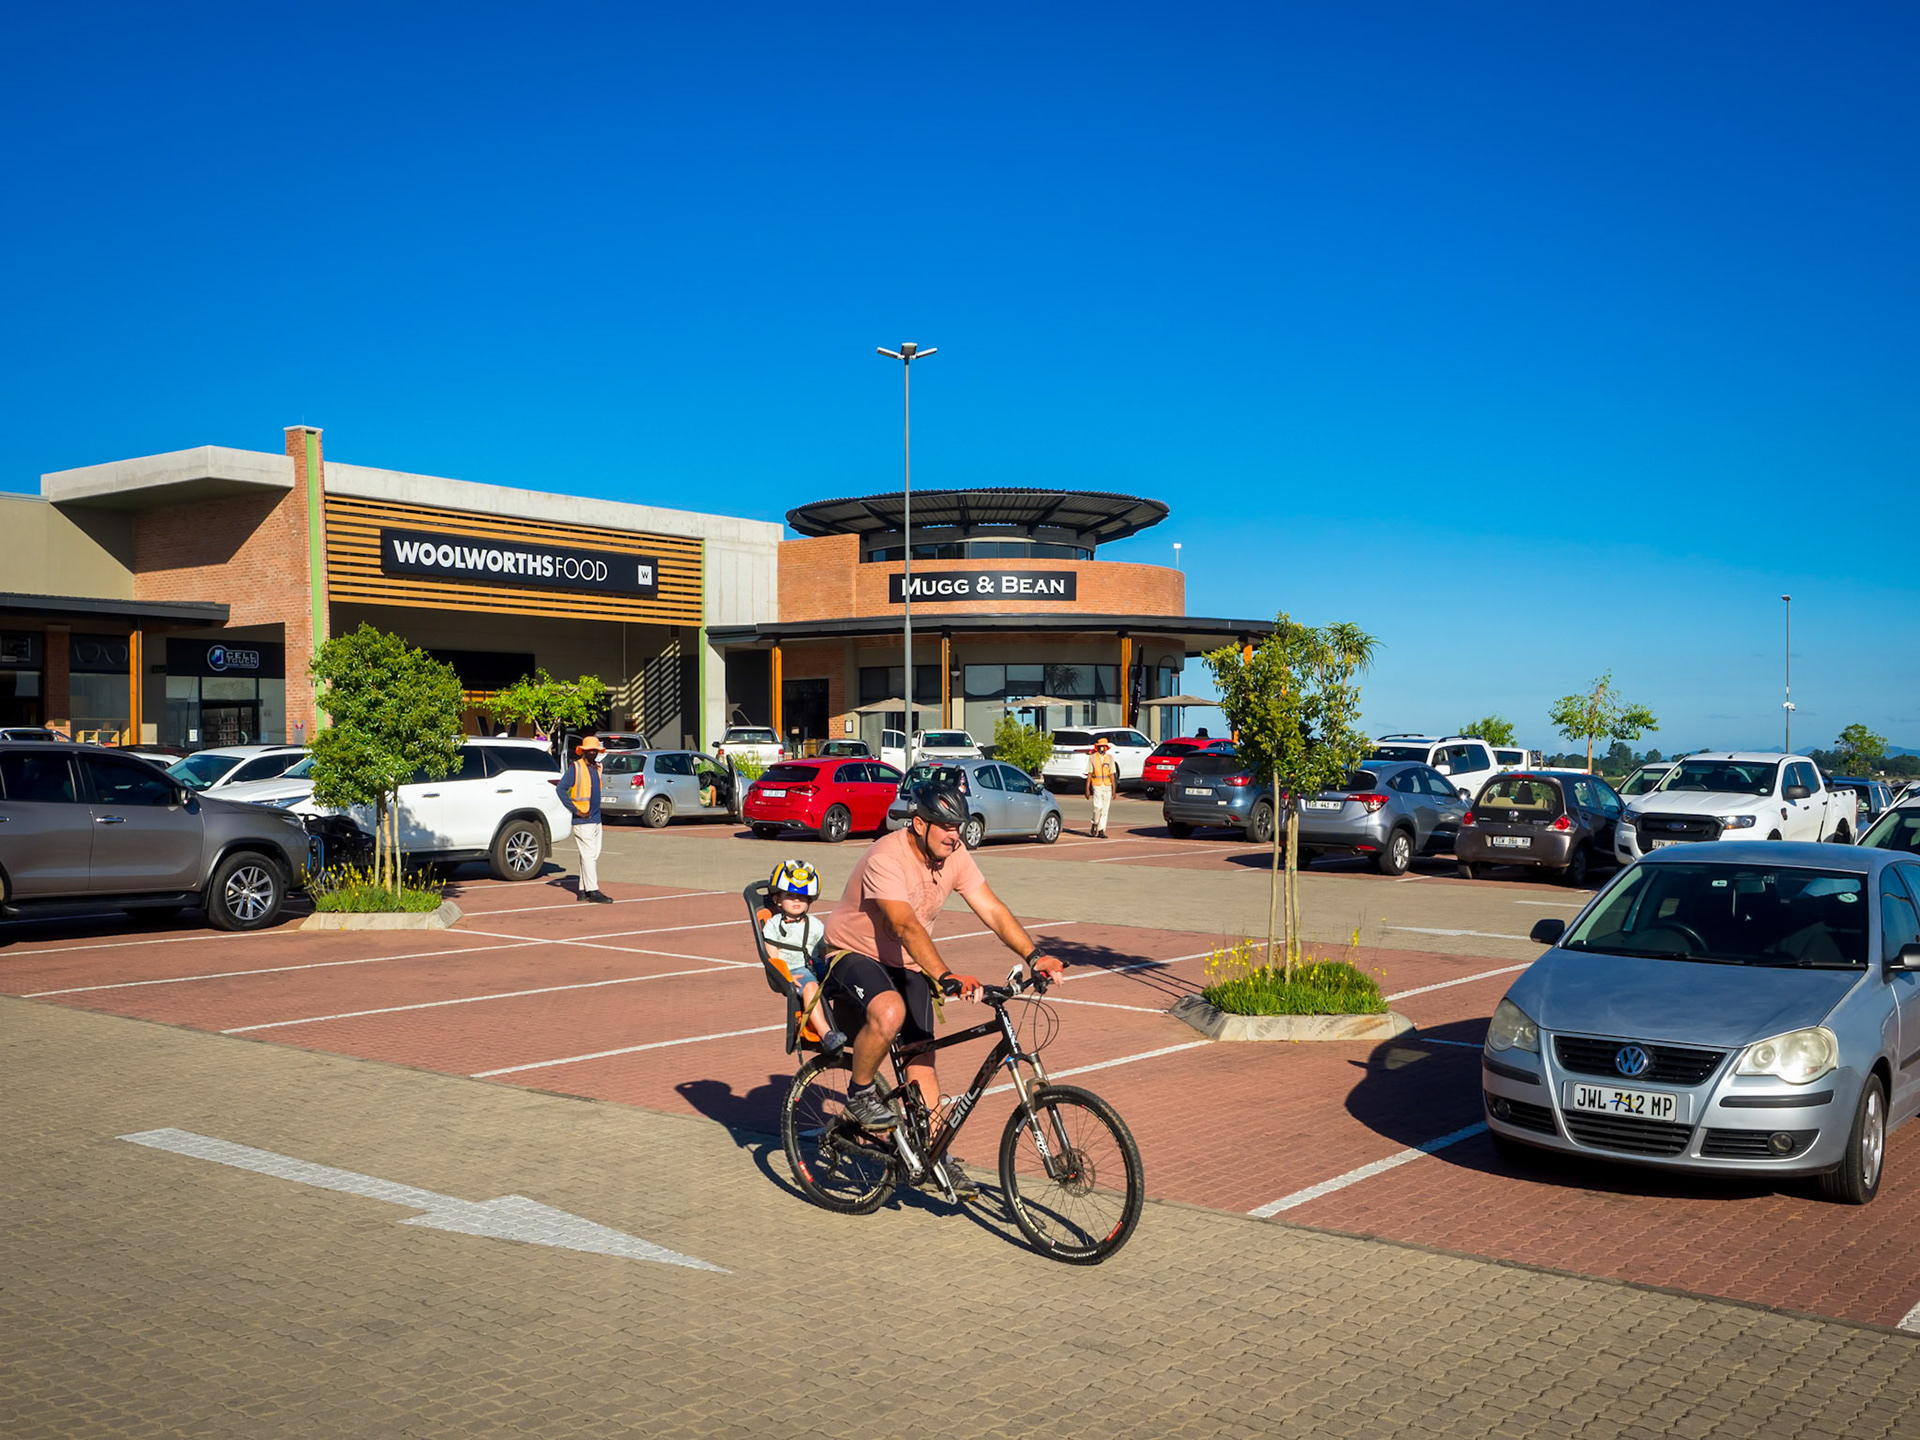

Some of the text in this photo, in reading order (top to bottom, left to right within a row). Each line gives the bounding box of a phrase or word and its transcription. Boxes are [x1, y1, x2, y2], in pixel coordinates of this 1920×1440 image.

[976, 575, 995, 594] &
[1001, 576, 1065, 594] BEAN
[226, 651, 256, 660] CELL
[227, 657, 257, 665] TOUCH
[949, 1087, 981, 1129] BMC
[1577, 1087, 1672, 1117] JWL 712 MP
